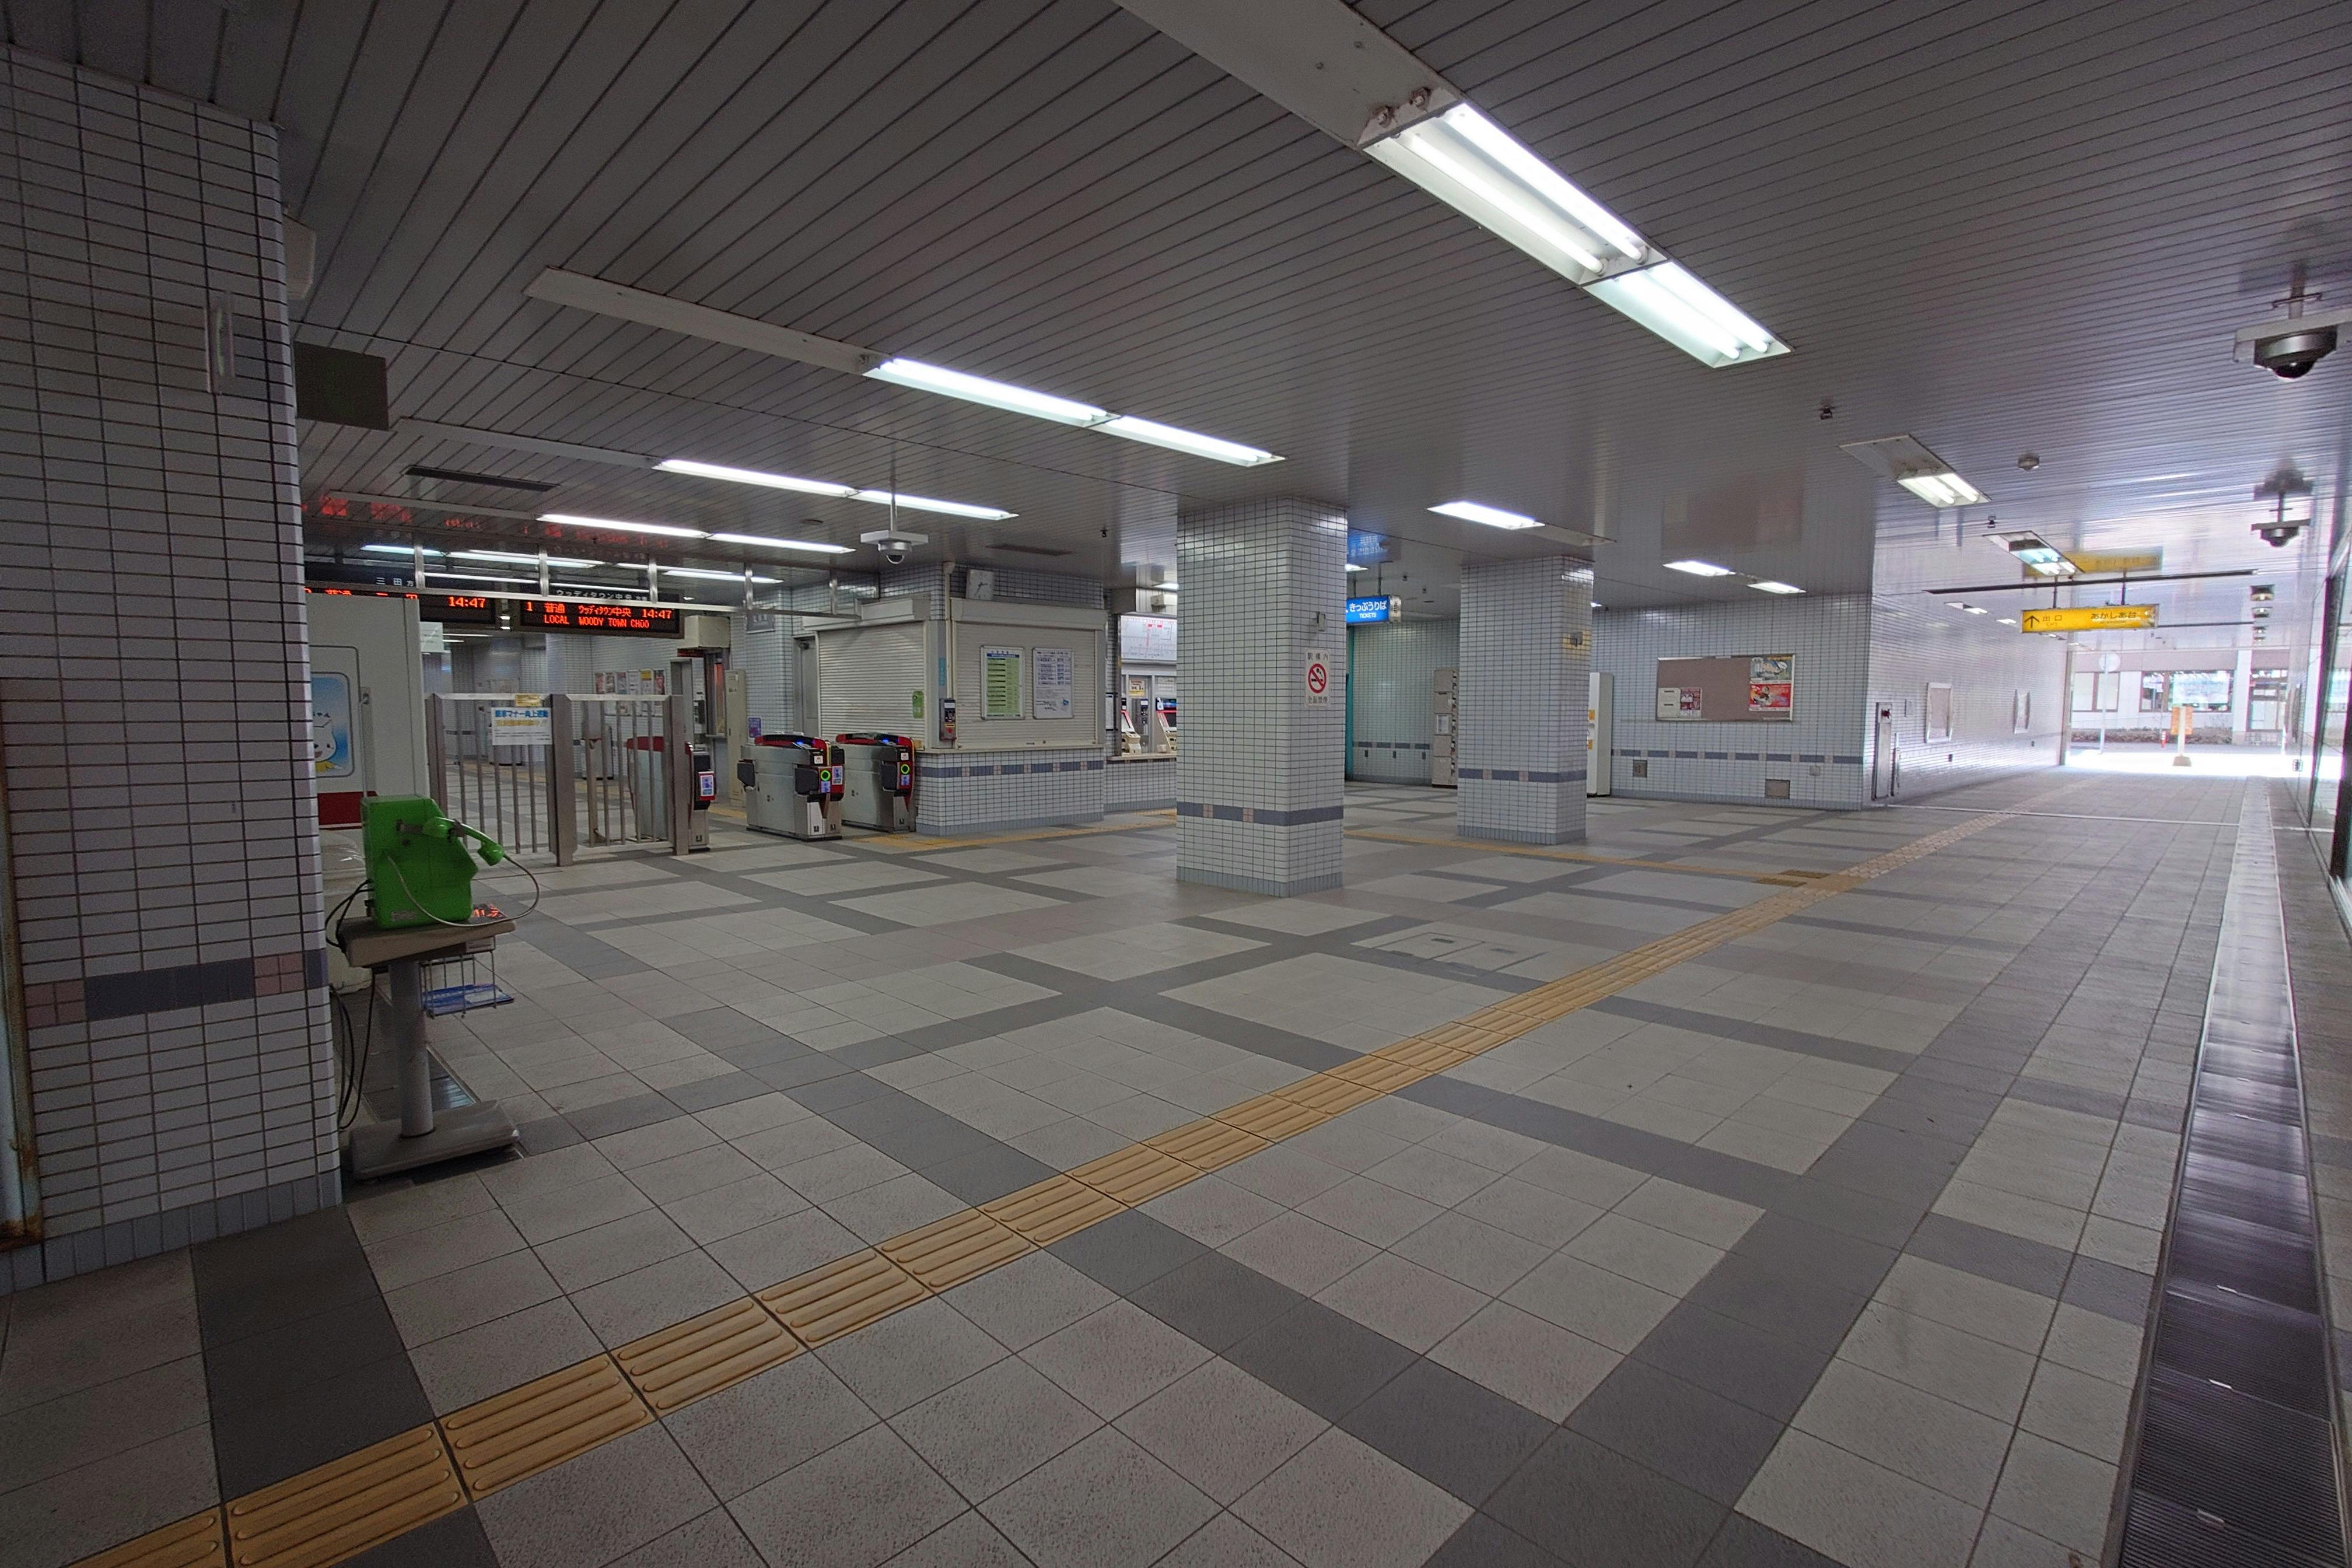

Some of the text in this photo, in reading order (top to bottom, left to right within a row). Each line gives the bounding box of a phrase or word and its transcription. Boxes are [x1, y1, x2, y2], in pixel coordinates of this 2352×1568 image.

[448, 596, 486, 608] 14:47
[1349, 600, 1388, 612] きっぷうりば
[526, 601, 533, 612] 1
[544, 603, 565, 614] 普通
[642, 608, 672, 619] 14:47
[544, 614, 570, 625] LOCAL
[578, 617, 604, 626] WOODY
[607, 617, 627, 628] TOWN
[2042, 611, 2137, 622] 出口 あかしあ台
